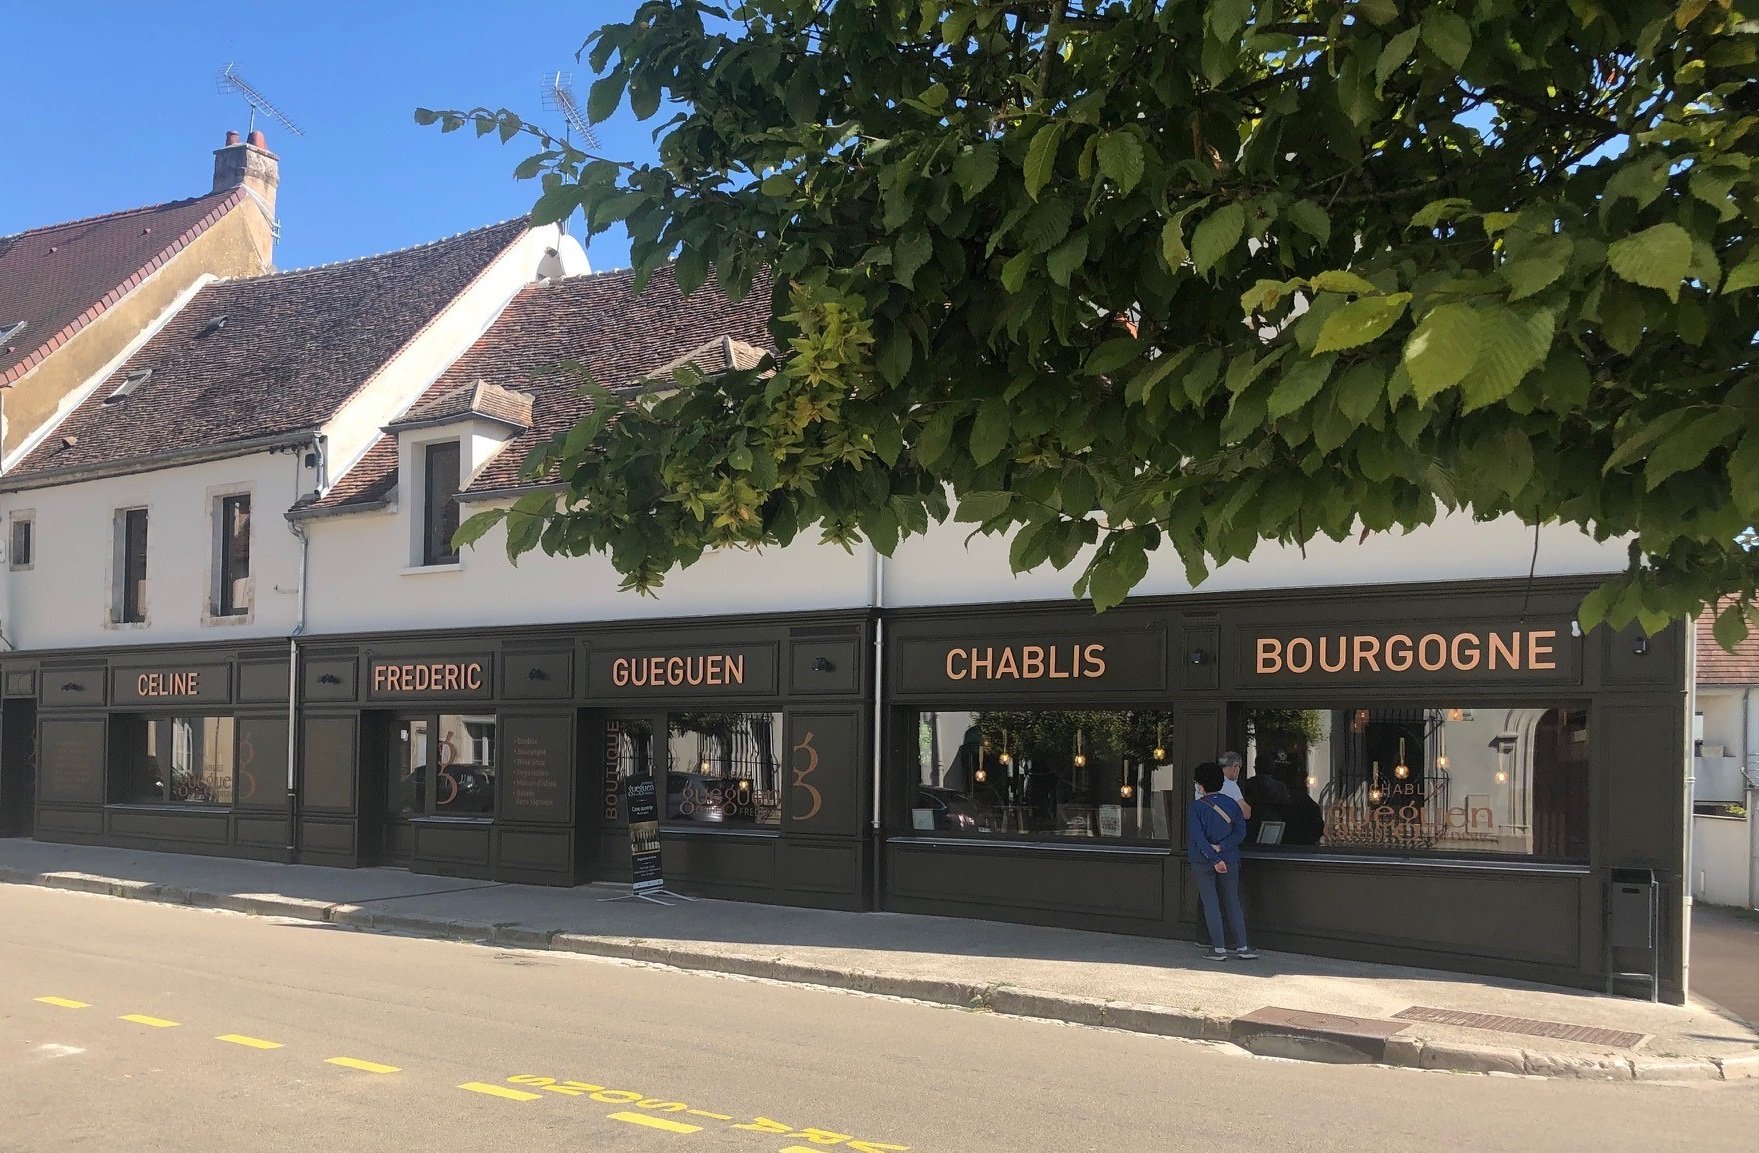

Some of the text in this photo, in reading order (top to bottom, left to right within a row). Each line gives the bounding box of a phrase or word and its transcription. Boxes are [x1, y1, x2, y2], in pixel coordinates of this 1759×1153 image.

[945, 643, 1107, 681] CHABLIS
[1255, 630, 1557, 674] BOURGOGNE
[138, 671, 199, 697] CELINE
[374, 662, 482, 691] FREDERIC
[612, 654, 745, 687] GUEGUEN
[604, 720, 620, 821] BOUTIQUE
